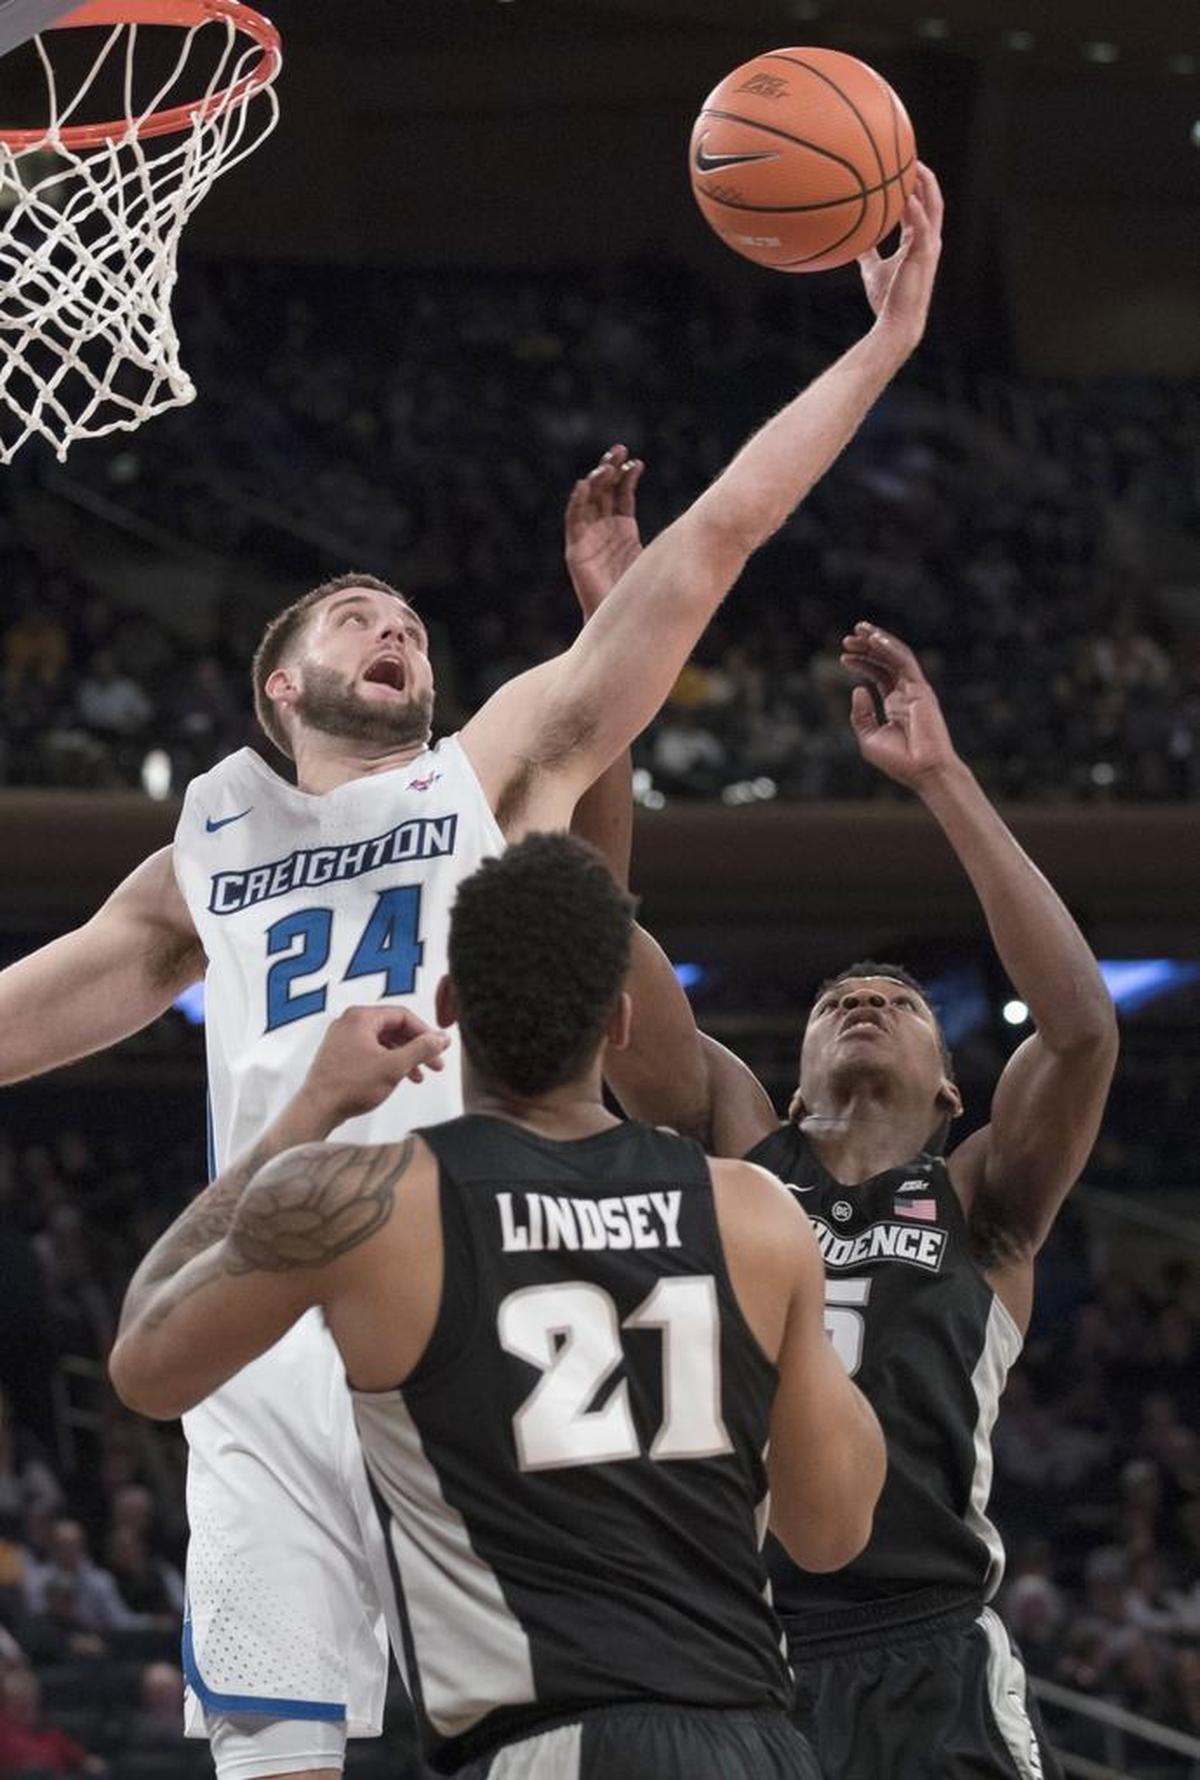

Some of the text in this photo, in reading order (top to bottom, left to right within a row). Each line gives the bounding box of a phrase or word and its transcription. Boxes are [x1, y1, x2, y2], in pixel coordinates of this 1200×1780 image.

[210, 815, 456, 912] CREIGHTON
[264, 884, 425, 1034] 24
[497, 1191, 682, 1251] LINDSEY
[497, 1275, 735, 1472] 21
